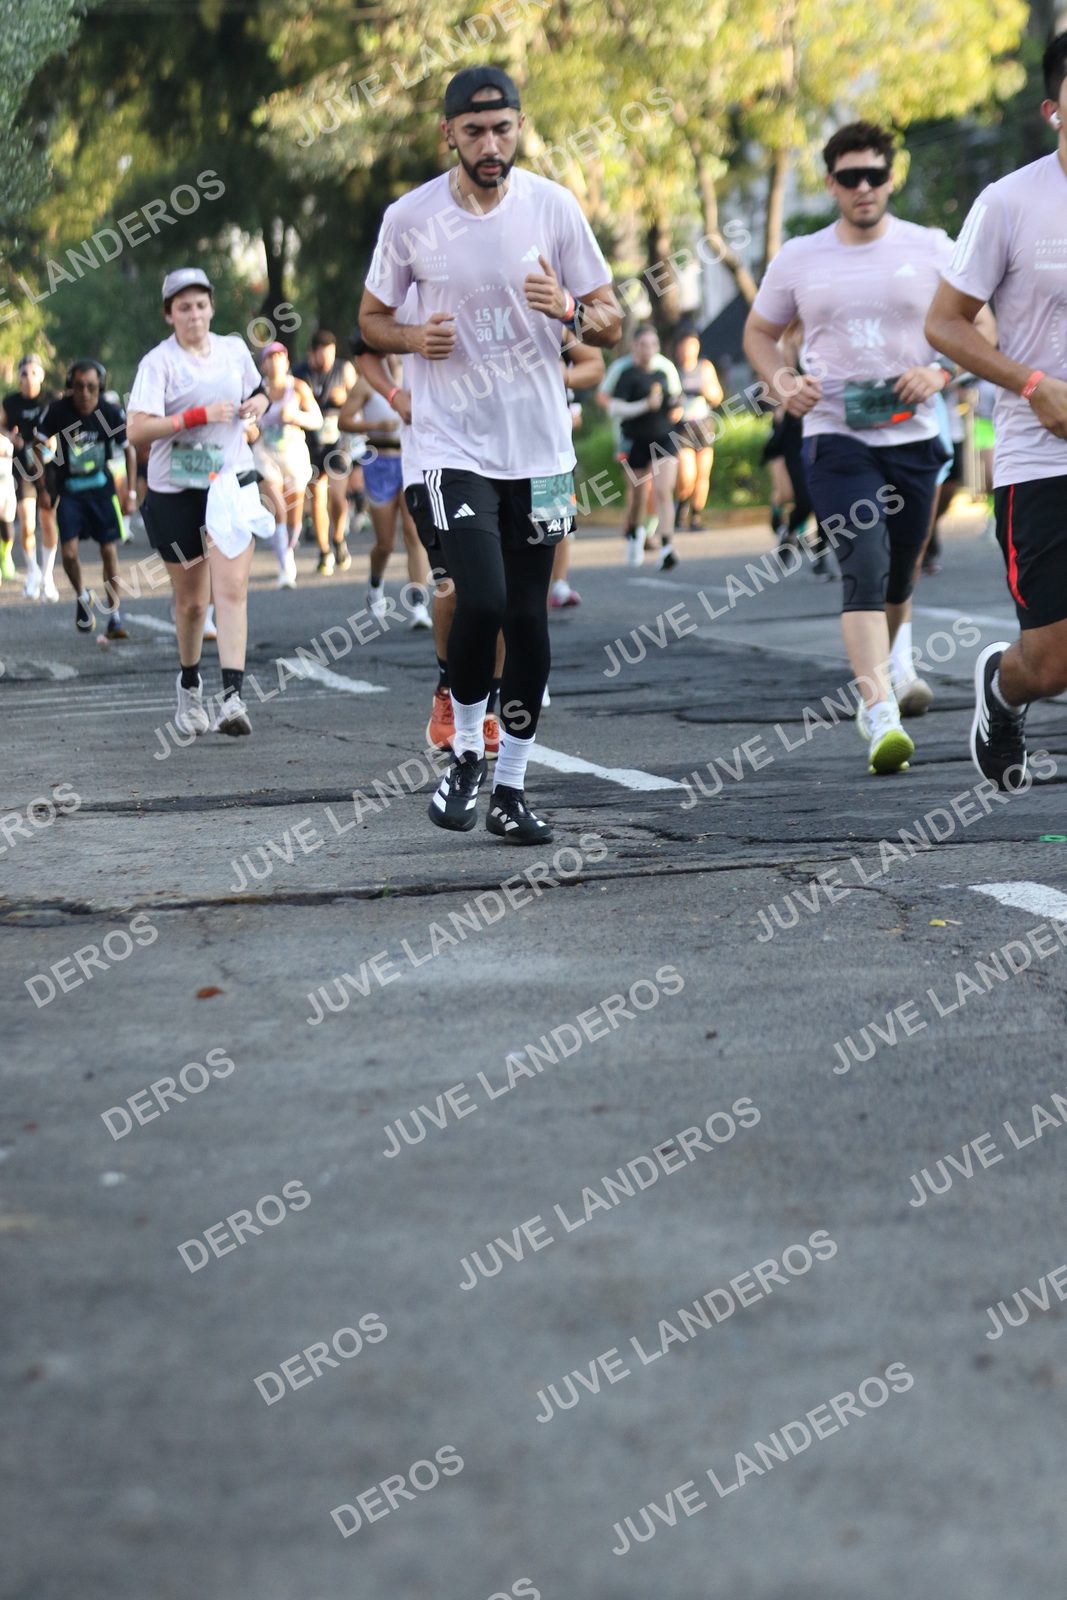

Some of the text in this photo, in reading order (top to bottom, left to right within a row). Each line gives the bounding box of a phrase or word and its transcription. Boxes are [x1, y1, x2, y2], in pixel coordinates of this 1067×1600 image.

[475, 307, 491, 323] 15
[494, 306, 517, 341] K
[476, 327, 493, 343] 30
